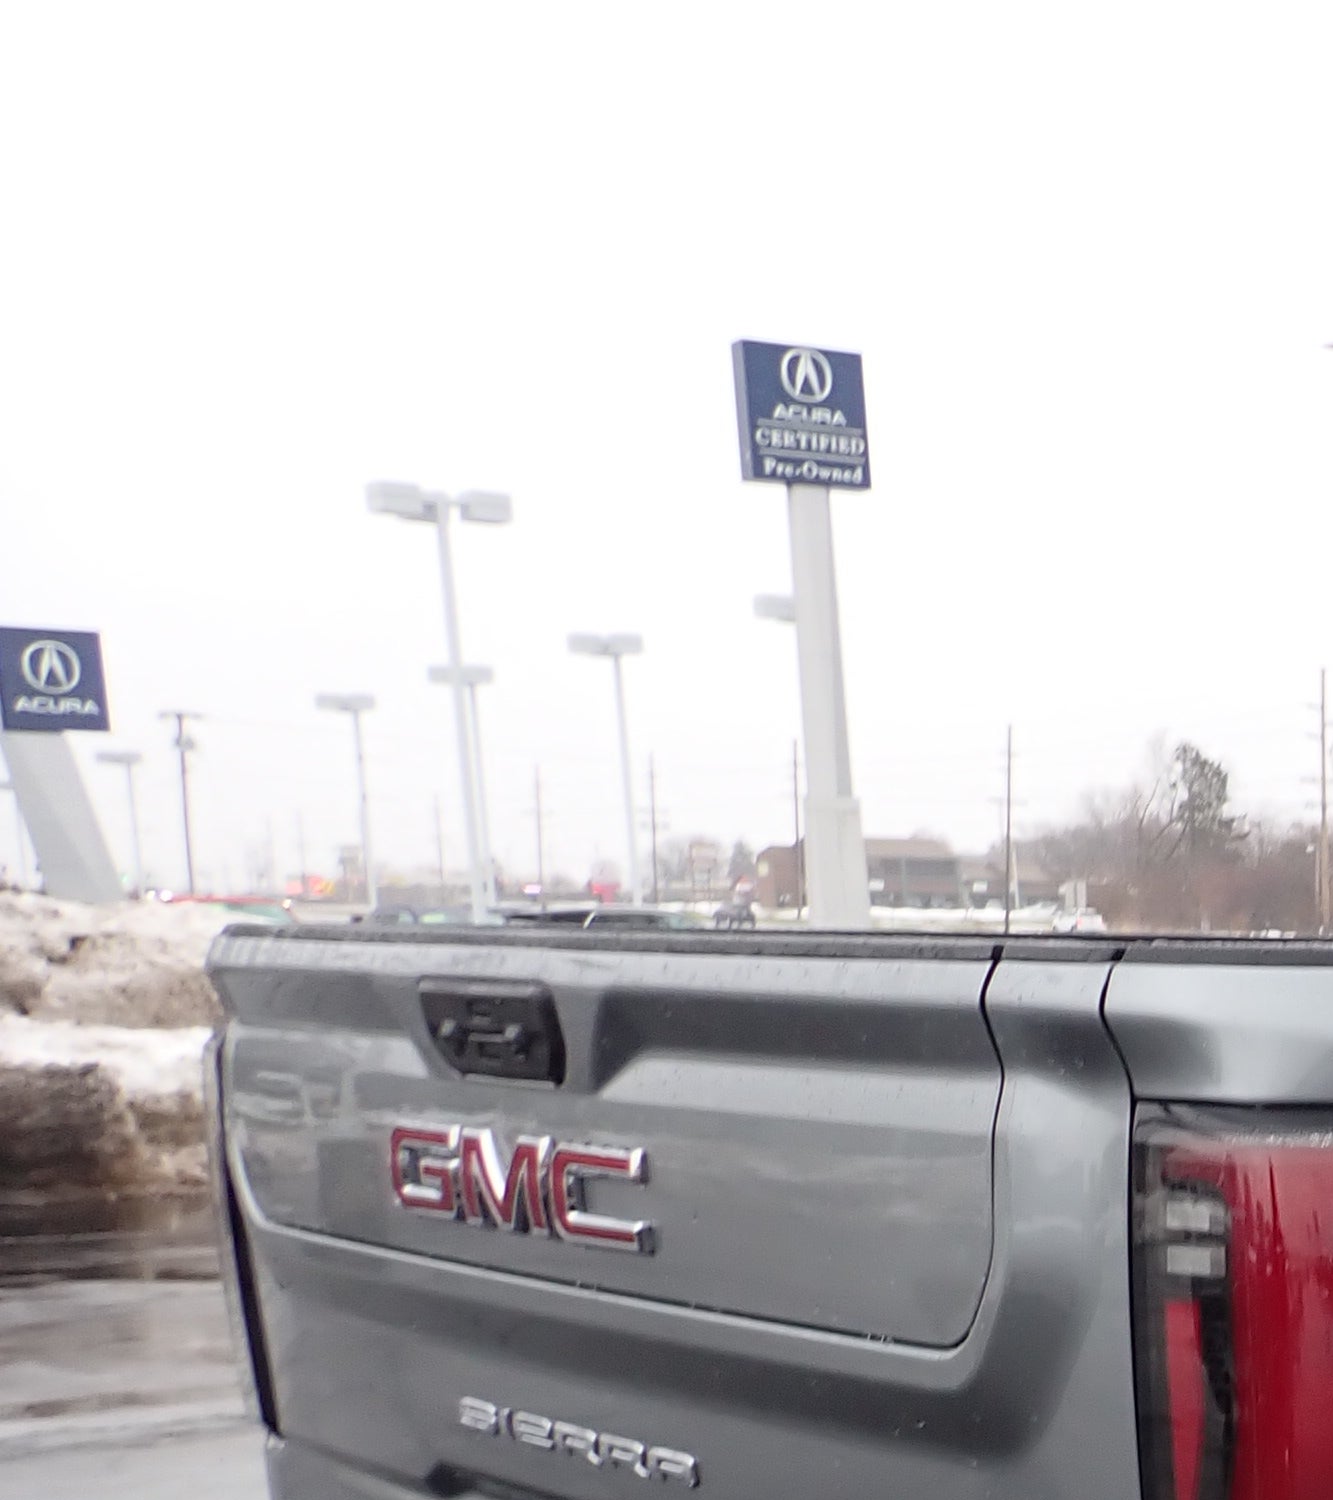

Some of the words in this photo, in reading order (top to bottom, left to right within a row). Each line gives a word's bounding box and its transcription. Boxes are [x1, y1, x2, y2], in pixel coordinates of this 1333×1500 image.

[773, 403, 847, 427] ACURA
[755, 427, 865, 455] CERTIFIED
[763, 456, 863, 484] Pre-Owned
[15, 695, 99, 716] ACURA
[390, 1123, 655, 1256] GMC
[459, 1396, 700, 1488] SIERRA
